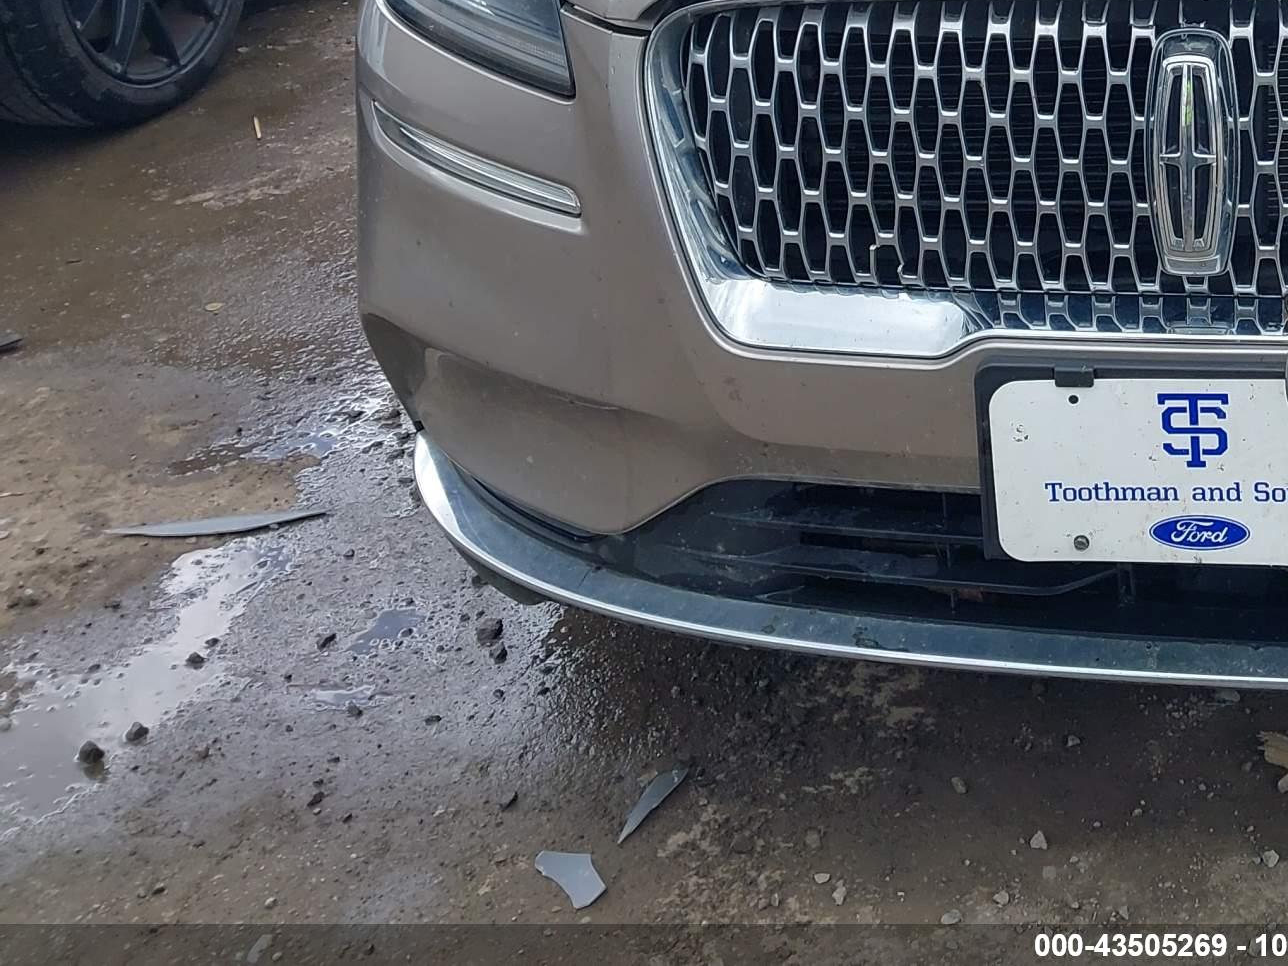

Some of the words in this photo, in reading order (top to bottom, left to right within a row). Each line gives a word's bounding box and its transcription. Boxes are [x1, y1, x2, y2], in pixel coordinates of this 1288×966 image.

[1046, 482, 1180, 504] Toothman
[1192, 481, 1243, 504] and
[1170, 520, 1229, 543] Ford
